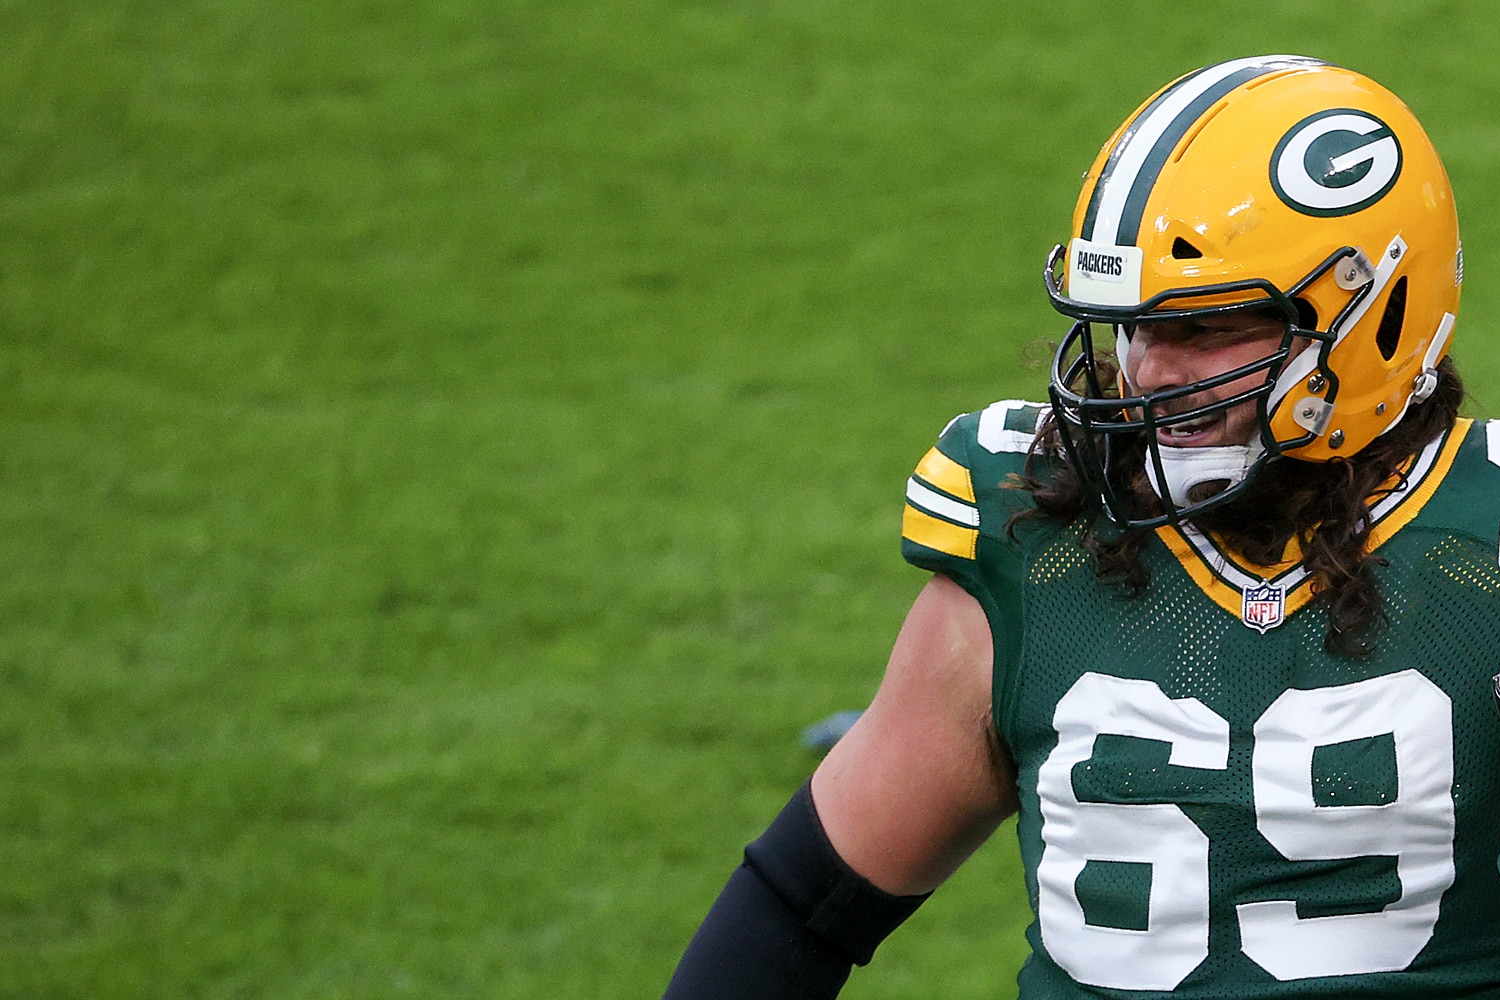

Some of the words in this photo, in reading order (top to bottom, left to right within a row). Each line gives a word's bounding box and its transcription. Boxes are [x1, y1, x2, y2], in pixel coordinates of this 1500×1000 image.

[1277, 113, 1400, 210] G
[1077, 250, 1123, 276] PACKERS
[1248, 602, 1277, 624] NFL
[1037, 668, 1456, 991] 69
